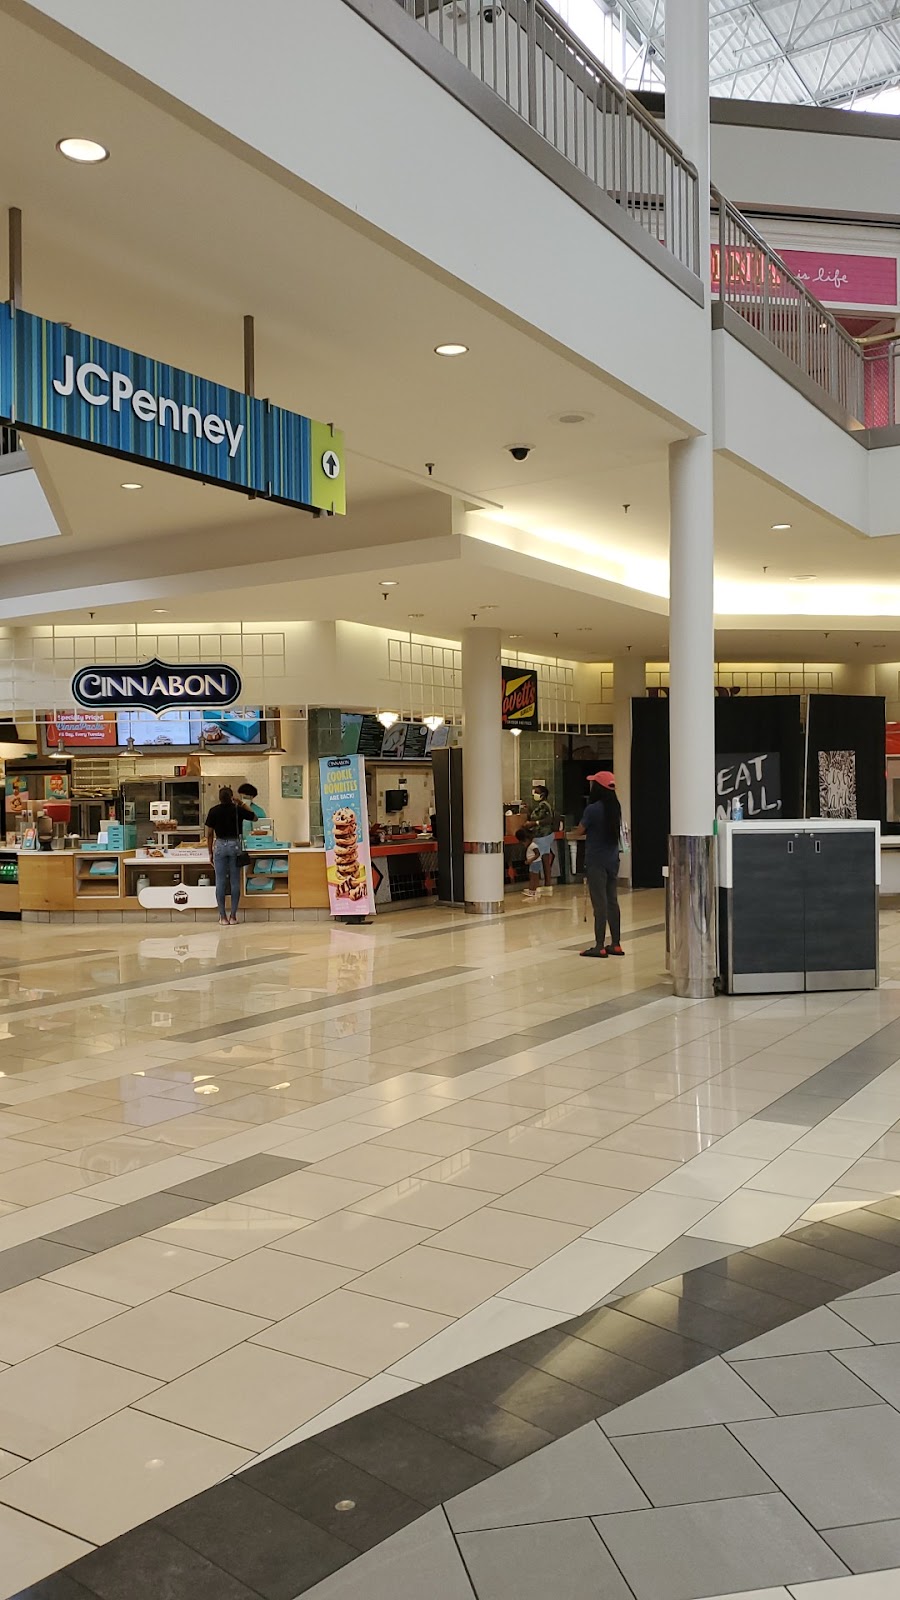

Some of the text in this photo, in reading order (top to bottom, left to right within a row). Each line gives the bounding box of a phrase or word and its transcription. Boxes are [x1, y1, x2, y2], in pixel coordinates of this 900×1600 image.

[794, 266, 849, 288] is life
[53, 354, 244, 457] JCPenney
[80, 674, 228, 698] CINNABON
[502, 678, 536, 713] ovett's
[327, 768, 353, 782] COOKIE
[716, 754, 768, 796] EAT
